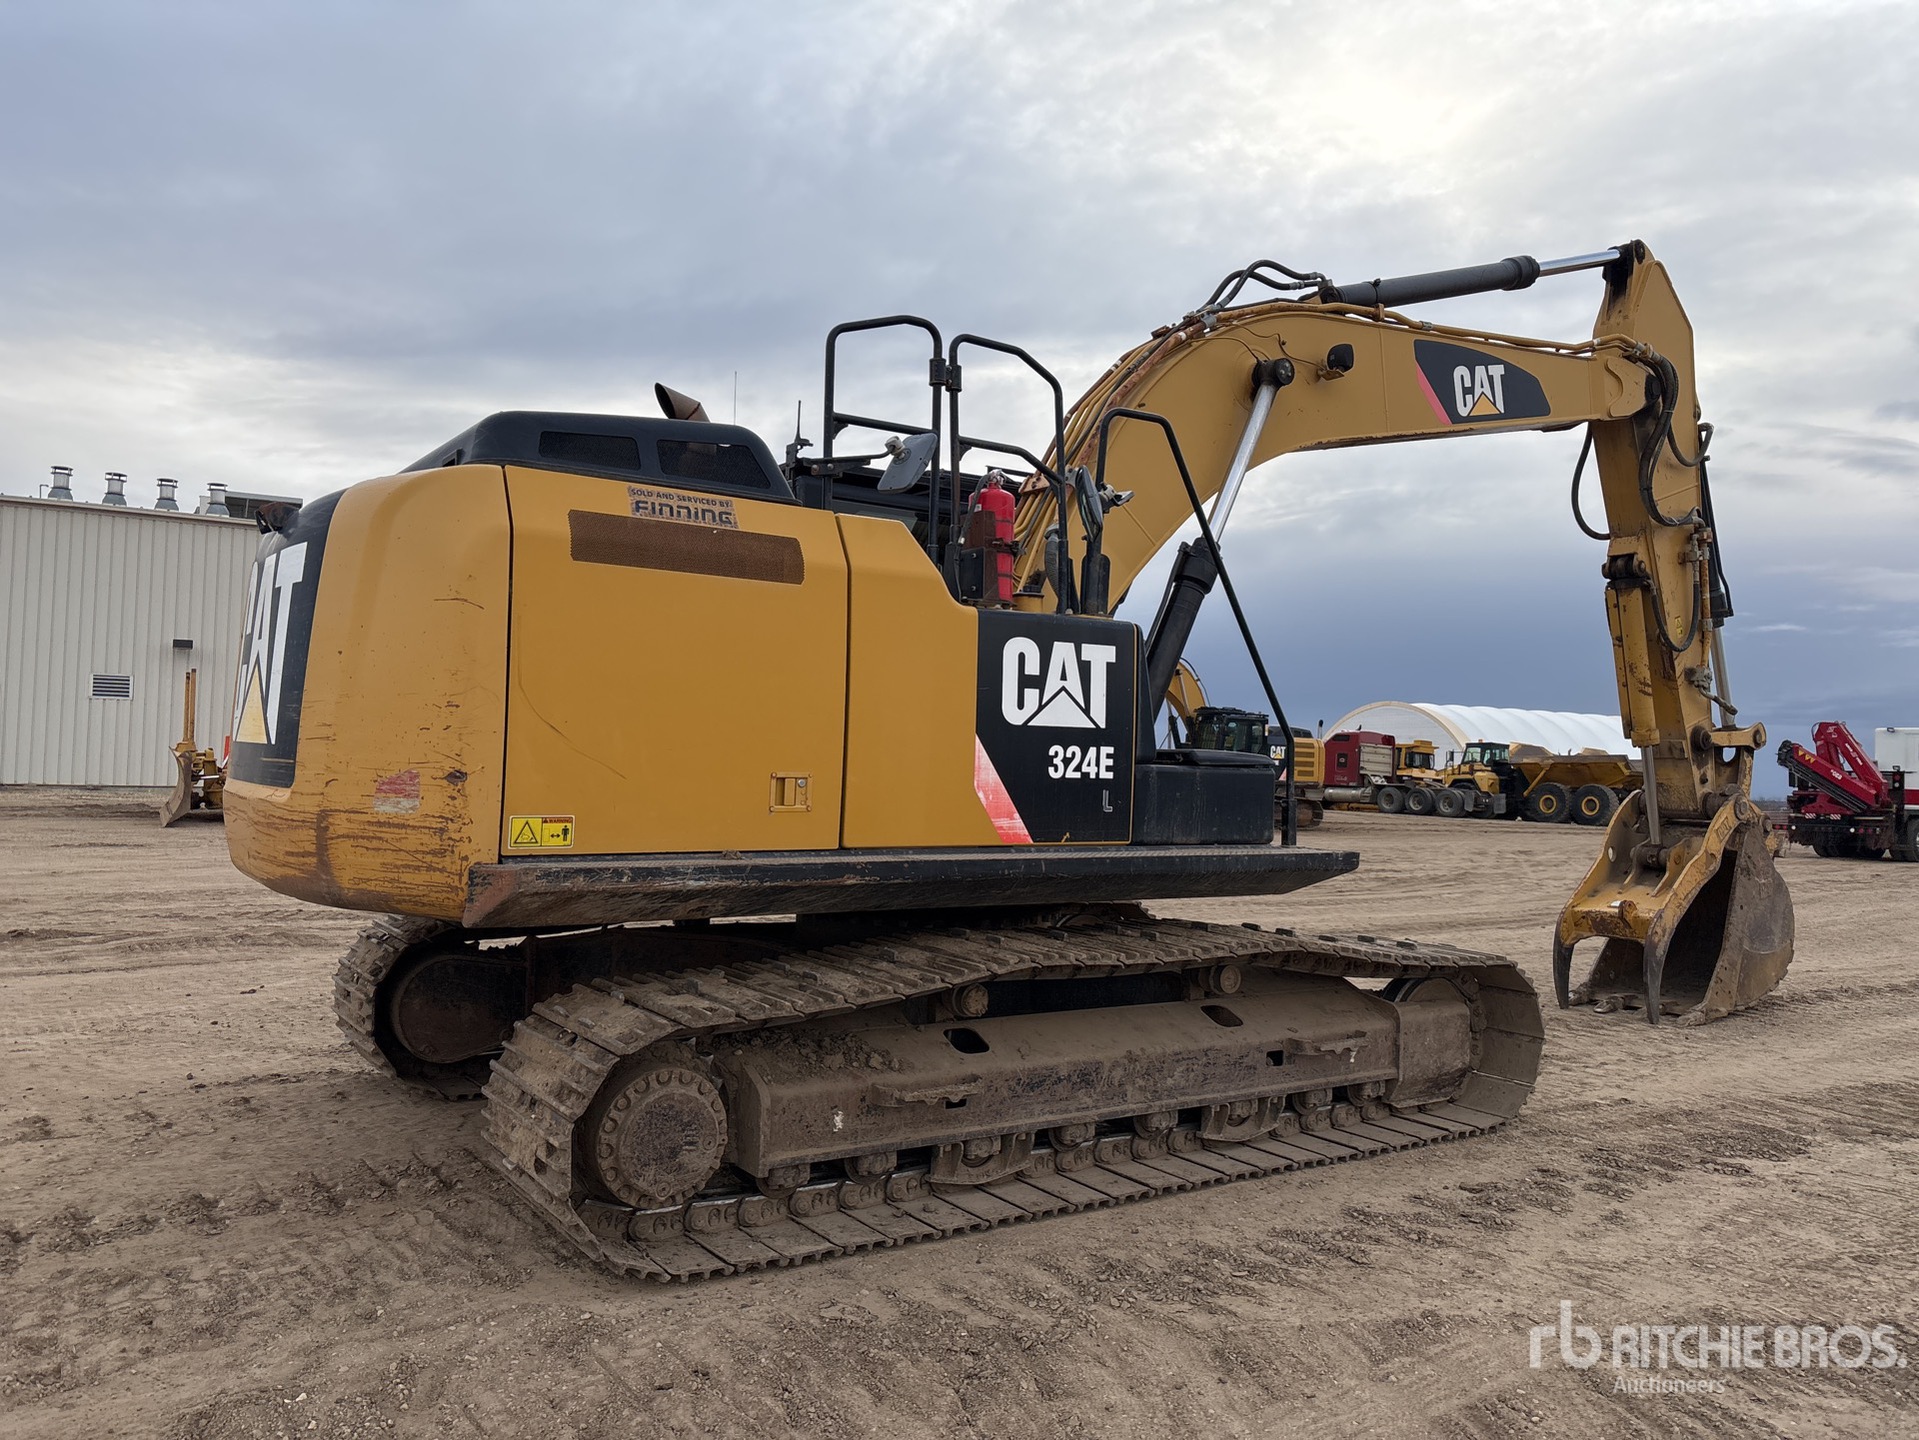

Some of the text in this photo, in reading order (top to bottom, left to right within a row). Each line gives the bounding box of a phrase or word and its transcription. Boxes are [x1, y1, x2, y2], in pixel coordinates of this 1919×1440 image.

[1453, 364, 1505, 417] CAT
[631, 488, 653, 498] SOLD
[656, 491, 675, 500] AND
[676, 496, 717, 506] SERVICED
[232, 541, 308, 745] CAT
[1001, 636, 1116, 729] CAT
[1048, 744, 1114, 779] 324E
[1270, 745, 1286, 759] CAT
[1102, 789, 1113, 812] L
